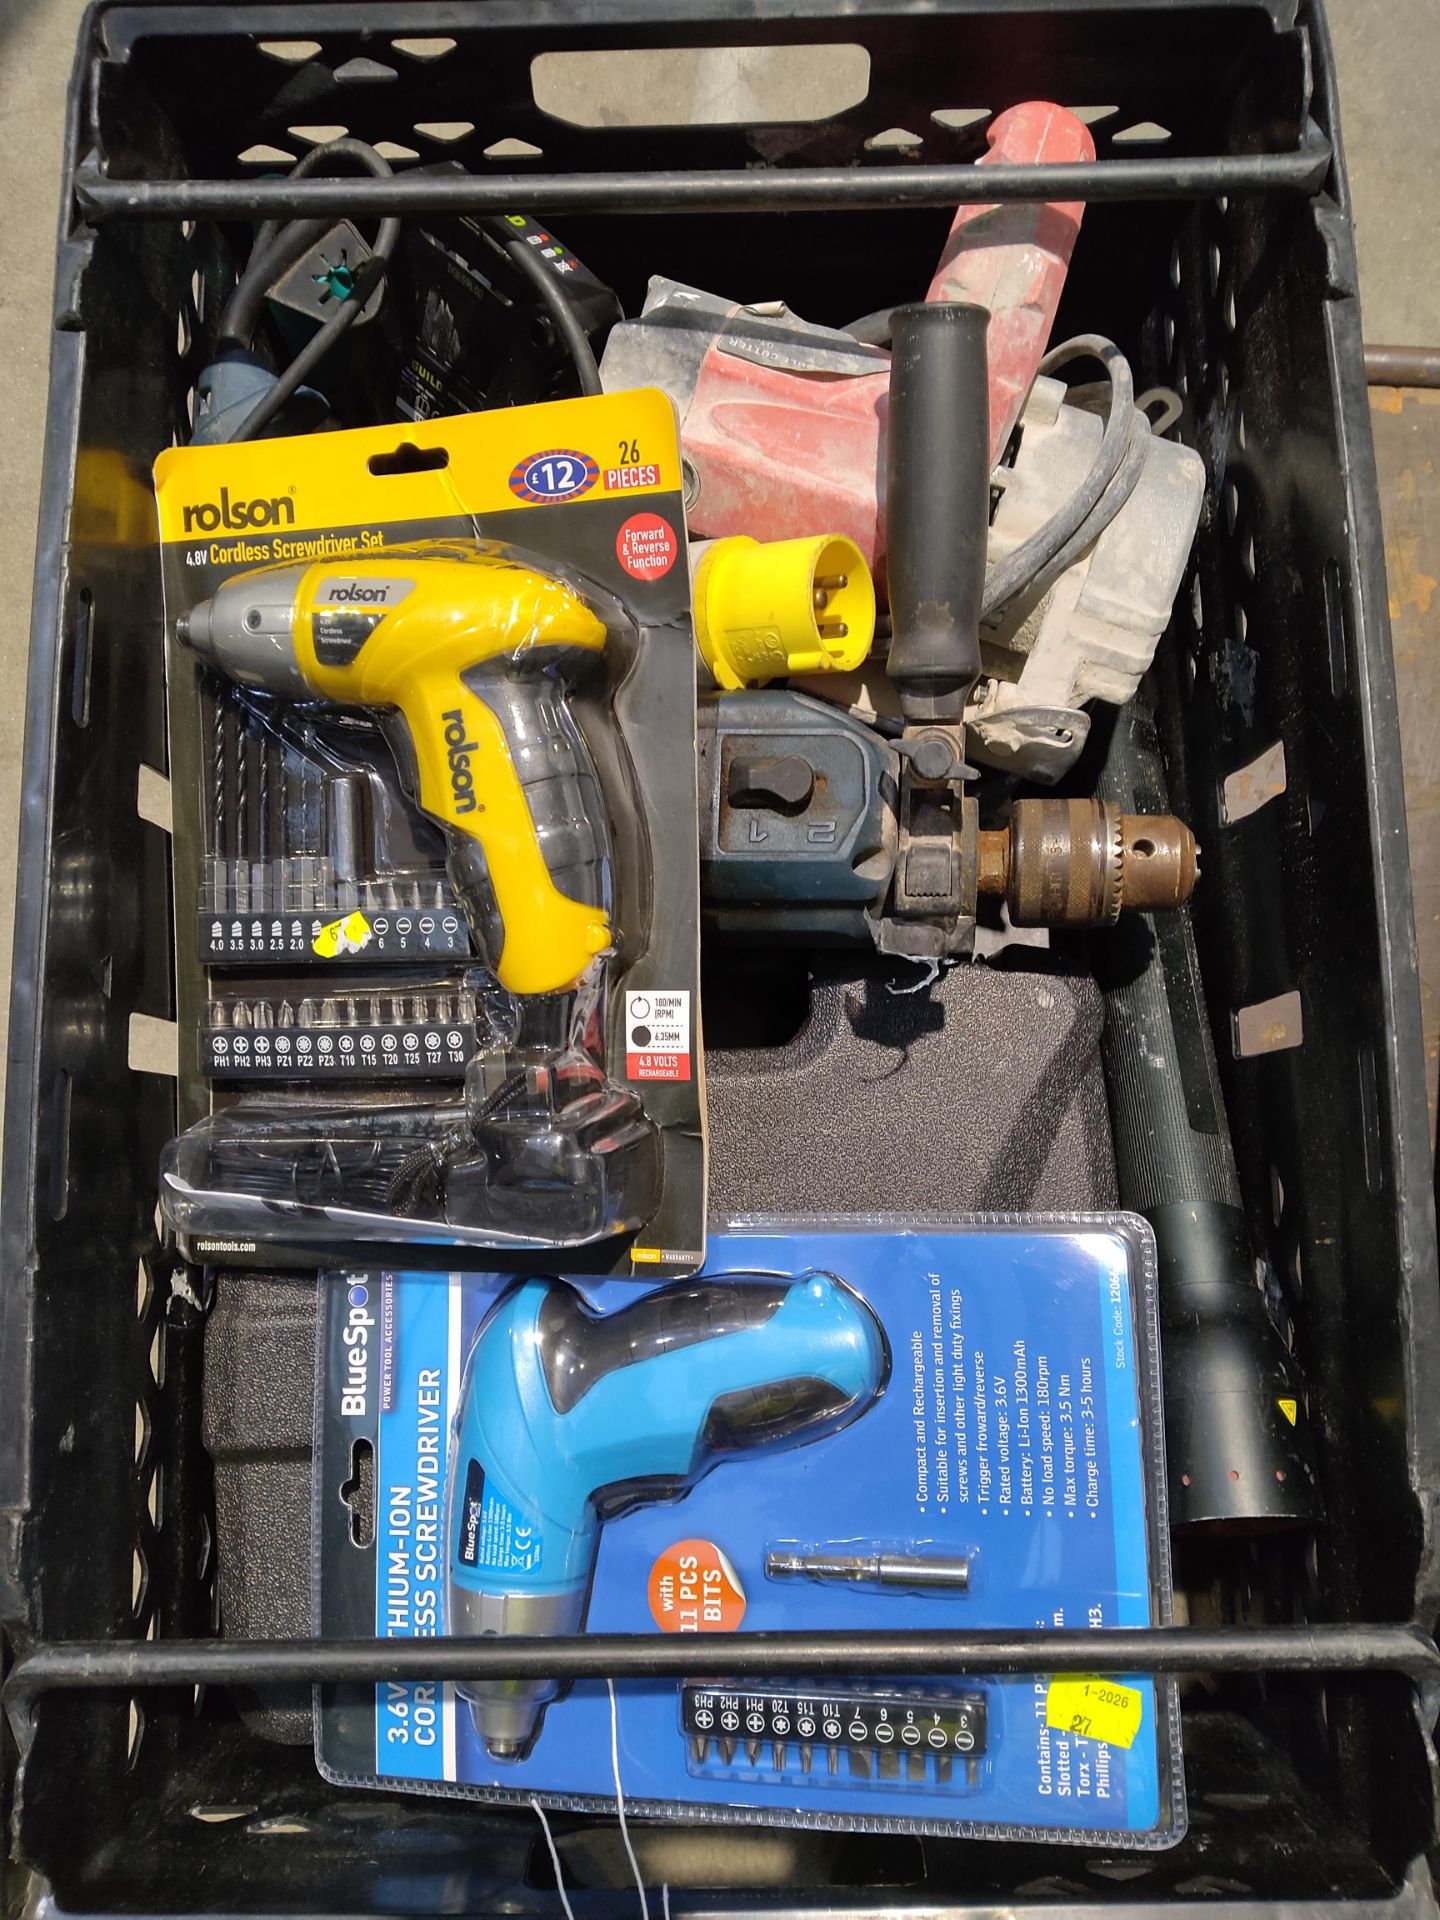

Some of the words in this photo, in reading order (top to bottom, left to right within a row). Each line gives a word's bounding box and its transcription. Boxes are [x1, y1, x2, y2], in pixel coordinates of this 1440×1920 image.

[618, 440, 640, 465] 26
[531, 461, 576, 490] £12
[608, 466, 656, 489] PIECES
[183, 487, 295, 532] rolson
[186, 550, 208, 567] 4.8V
[210, 543, 270, 565] Cordless
[273, 534, 357, 559] Screwdriver
[361, 530, 384, 548] Set
[622, 544, 630, 556] &
[632, 540, 670, 554] Reverse
[625, 526, 664, 542] Forward
[628, 556, 668, 568] Function
[328, 583, 386, 602] rolson
[442, 709, 479, 814] rolson
[210, 940, 224, 951] 4.0
[230, 940, 244, 951] 3.5
[250, 939, 264, 950] 3.0
[270, 939, 284, 950] 2.5
[290, 938, 304, 950] 2.0
[378, 938, 384, 948] 6
[400, 937, 406, 948] 5
[424, 937, 430, 948] 4
[448, 936, 454, 948] 3
[655, 1032, 680, 1042] 6.35MM
[214, 1056, 230, 1067] PH1
[234, 1056, 250, 1067] PH2
[255, 1056, 272, 1067] PH3
[277, 1056, 292, 1066] PZ1
[298, 1056, 313, 1066] PZ2
[318, 1055, 334, 1066] PZ3
[340, 1054, 355, 1066] T10
[362, 1054, 376, 1065] T15
[383, 1054, 398, 1065] T20
[404, 1053, 420, 1064] T25
[426, 1052, 442, 1064] T27
[448, 1050, 464, 1062] T30
[639, 1056, 652, 1066] 4.8
[654, 1056, 678, 1067] VOLTS
[197, 1240, 256, 1252] rolsontools.com
[928, 1272, 940, 1285] of
[385, 1274, 393, 1343] ACCESSORIES
[930, 1290, 943, 1339] removal
[949, 1289, 962, 1330] fixings
[1112, 1306, 1124, 1335] Code:
[384, 1346, 392, 1370] TOOL
[932, 1343, 943, 1365] and
[950, 1333, 964, 1360] duty
[1115, 1339, 1125, 1368] Stock
[911, 1331, 925, 1415] Rechargeable
[952, 1363, 965, 1391] light
[1014, 1340, 1028, 1404] 1300mAh
[1036, 1356, 1051, 1406] 180rpm
[1059, 1374, 1071, 1397] Nm
[1079, 1358, 1093, 1392] hours
[383, 1373, 392, 1409] POWER
[933, 1369, 946, 1423] insertion
[973, 1351, 988, 1451] froward/reverse
[994, 1376, 1007, 1407] 3.6V
[954, 1397, 966, 1429] other
[1059, 1402, 1072, 1423] 3.5
[1082, 1397, 1094, 1419] 3-5
[914, 1420, 926, 1443] and
[935, 1427, 946, 1445] for
[996, 1412, 1011, 1462] voltage:
[1017, 1408, 1031, 1447] Li-Ion
[1039, 1411, 1054, 1452] speed:
[1083, 1423, 1096, 1456] time:
[955, 1433, 967, 1456] and
[1061, 1427, 1077, 1473] torque:
[415, 1369, 441, 1582] SCREWDRIVER
[916, 1447, 928, 1502] Compact
[936, 1450, 949, 1502] Suitable
[957, 1459, 968, 1503] screws
[977, 1456, 991, 1503] Trigger
[1020, 1452, 1034, 1505] Battery:
[1041, 1456, 1053, 1483] load
[1086, 1461, 1100, 1507] Charge
[1000, 1467, 1011, 1504] Rated
[1042, 1487, 1054, 1505] No
[1064, 1478, 1077, 1505] Max
[680, 1556, 697, 1600] PCS
[660, 1576, 673, 1612] with
[703, 1570, 721, 1621] BITS
[680, 1608, 697, 1632] 11
[388, 1682, 408, 1744] 3.6V
[694, 1694, 713, 1708] PH3
[720, 1696, 739, 1710] PH2
[746, 1697, 763, 1711] PH1
[772, 1700, 789, 1714] T20
[798, 1701, 814, 1716] T15
[823, 1702, 840, 1717] T10
[854, 1706, 860, 1719] 7
[881, 1708, 888, 1721] 6
[906, 1710, 914, 1723] 5
[934, 1712, 940, 1725] 4
[960, 1715, 967, 1728] 3
[1058, 1740, 1071, 1796] Slotted
[1077, 1762, 1090, 1797] Torx
[1096, 1742, 1112, 1798] Phillips
